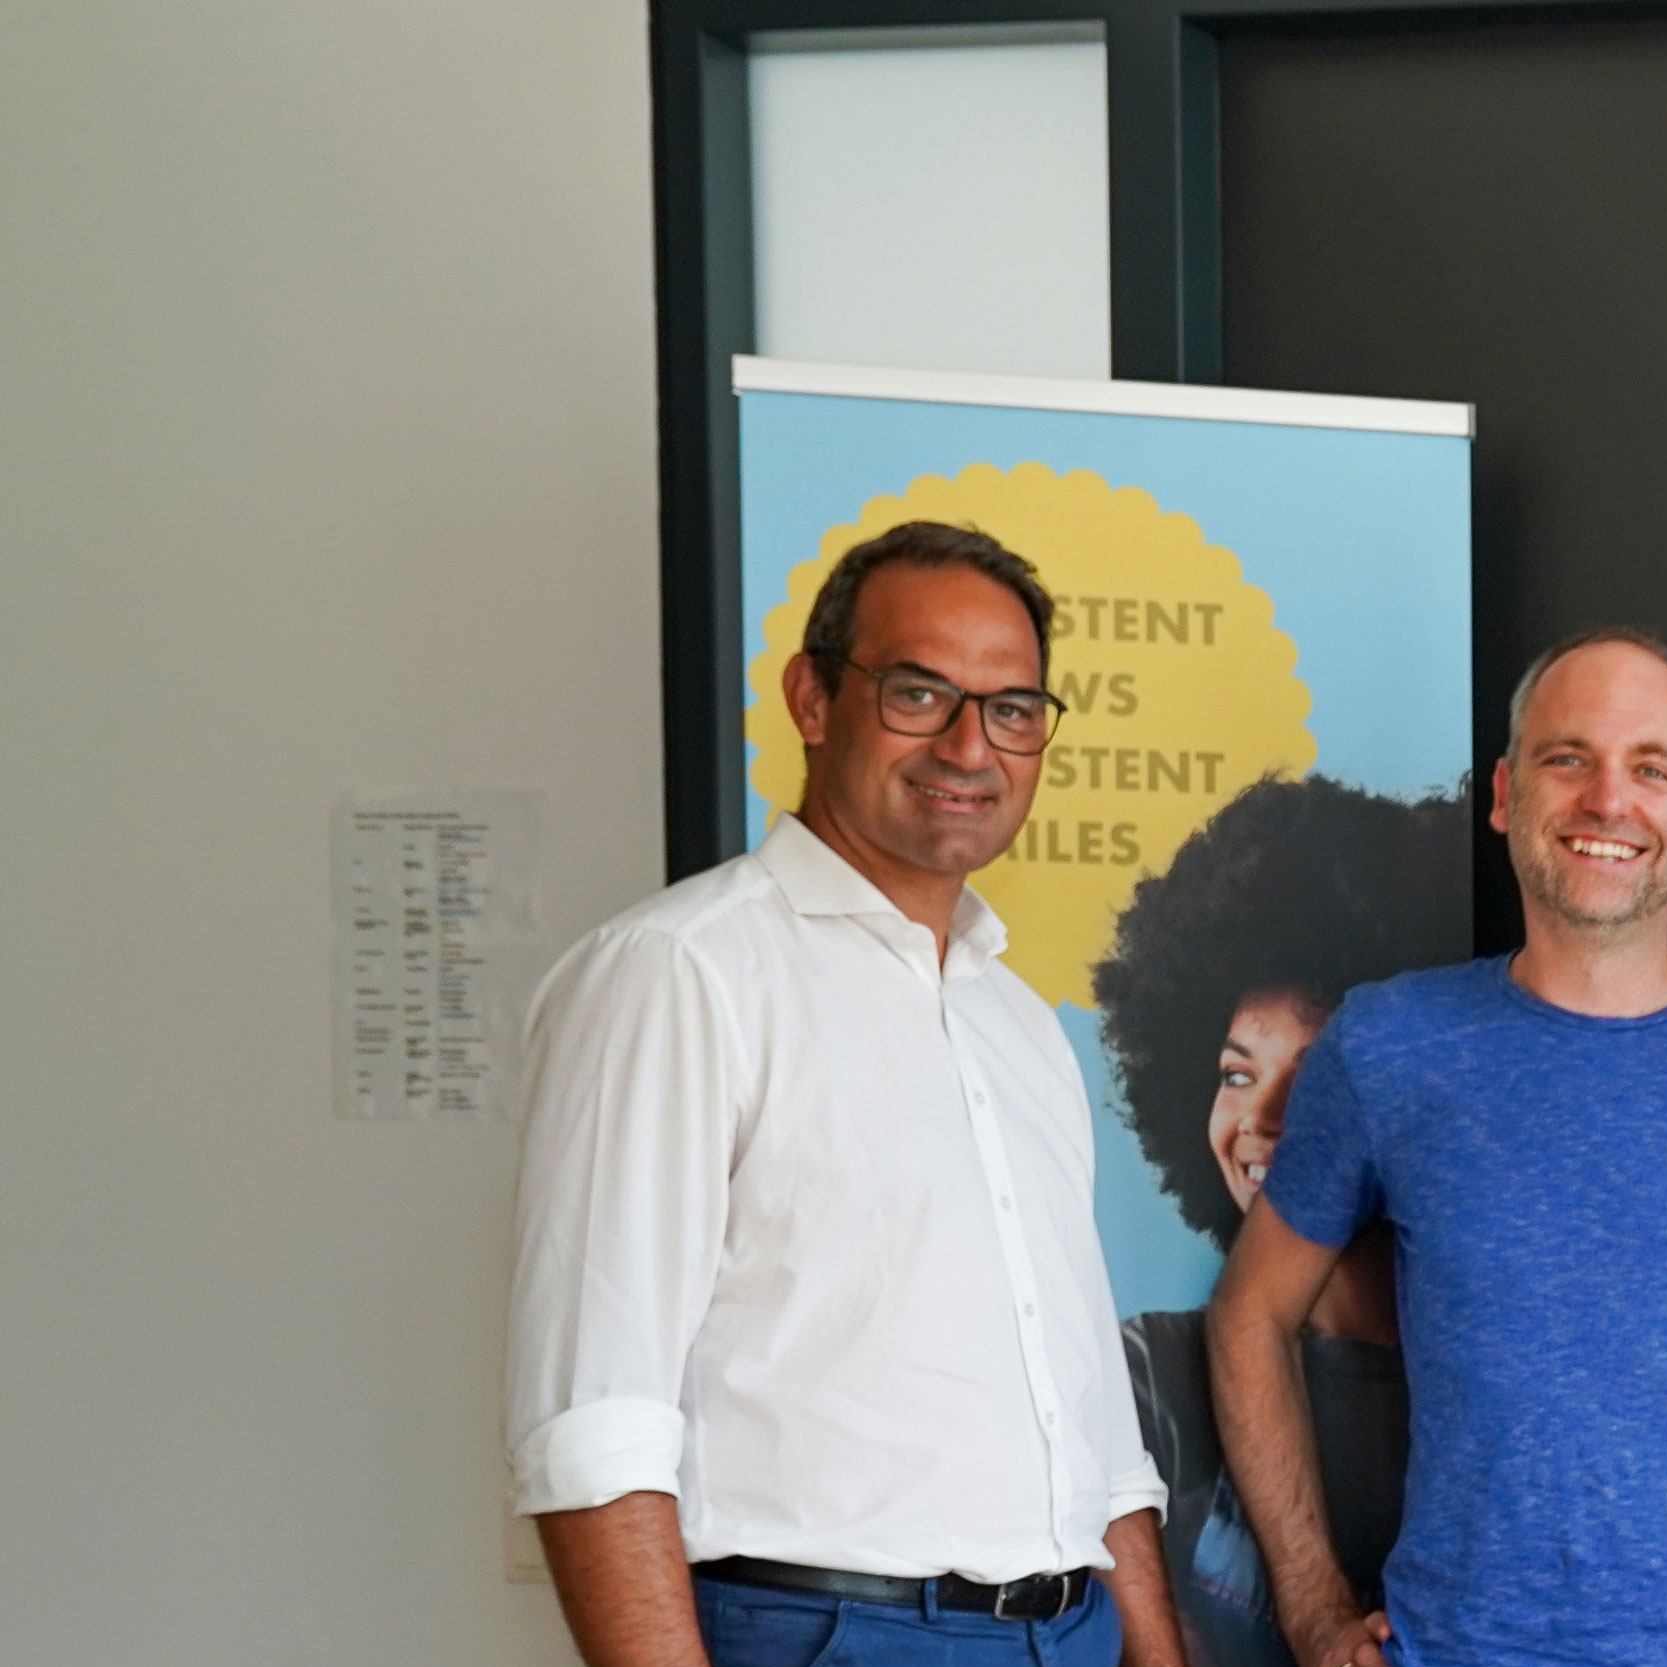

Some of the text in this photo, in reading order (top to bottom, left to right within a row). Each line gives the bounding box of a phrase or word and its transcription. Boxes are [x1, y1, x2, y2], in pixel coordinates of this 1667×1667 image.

[1051, 595, 1225, 646] STENT
[1059, 671, 1140, 717] WS
[1046, 746, 1225, 795] STENT
[1004, 819, 1143, 867] ILES
